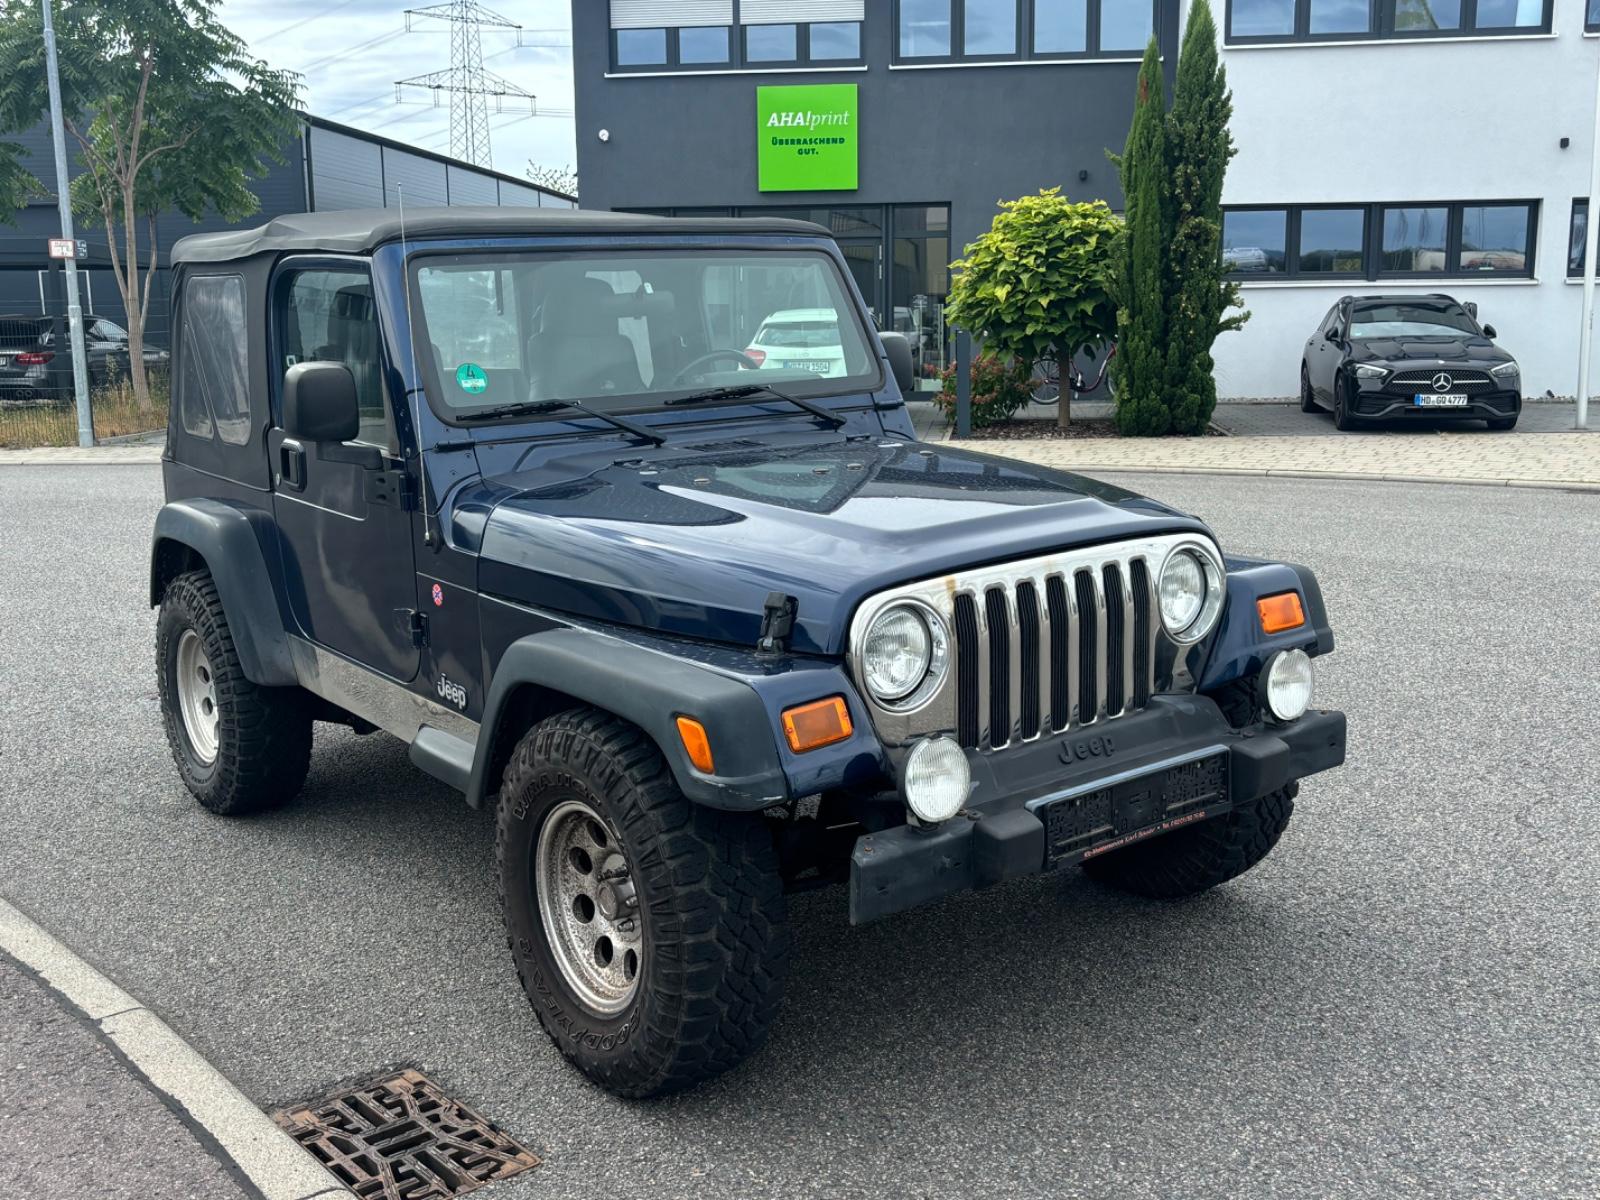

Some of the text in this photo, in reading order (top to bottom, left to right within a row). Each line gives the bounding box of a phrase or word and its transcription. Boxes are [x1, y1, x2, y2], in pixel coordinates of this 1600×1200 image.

[766, 111, 851, 131] AHA!print
[771, 136, 846, 146] ÜBERRASCHEND
[797, 147, 819, 156] GUT.
[466, 364, 476, 379] 4
[1421, 395, 1432, 405] HD
[1448, 395, 1467, 405] 4777
[437, 672, 467, 710] Jeep
[1058, 736, 1116, 765] Jeep
